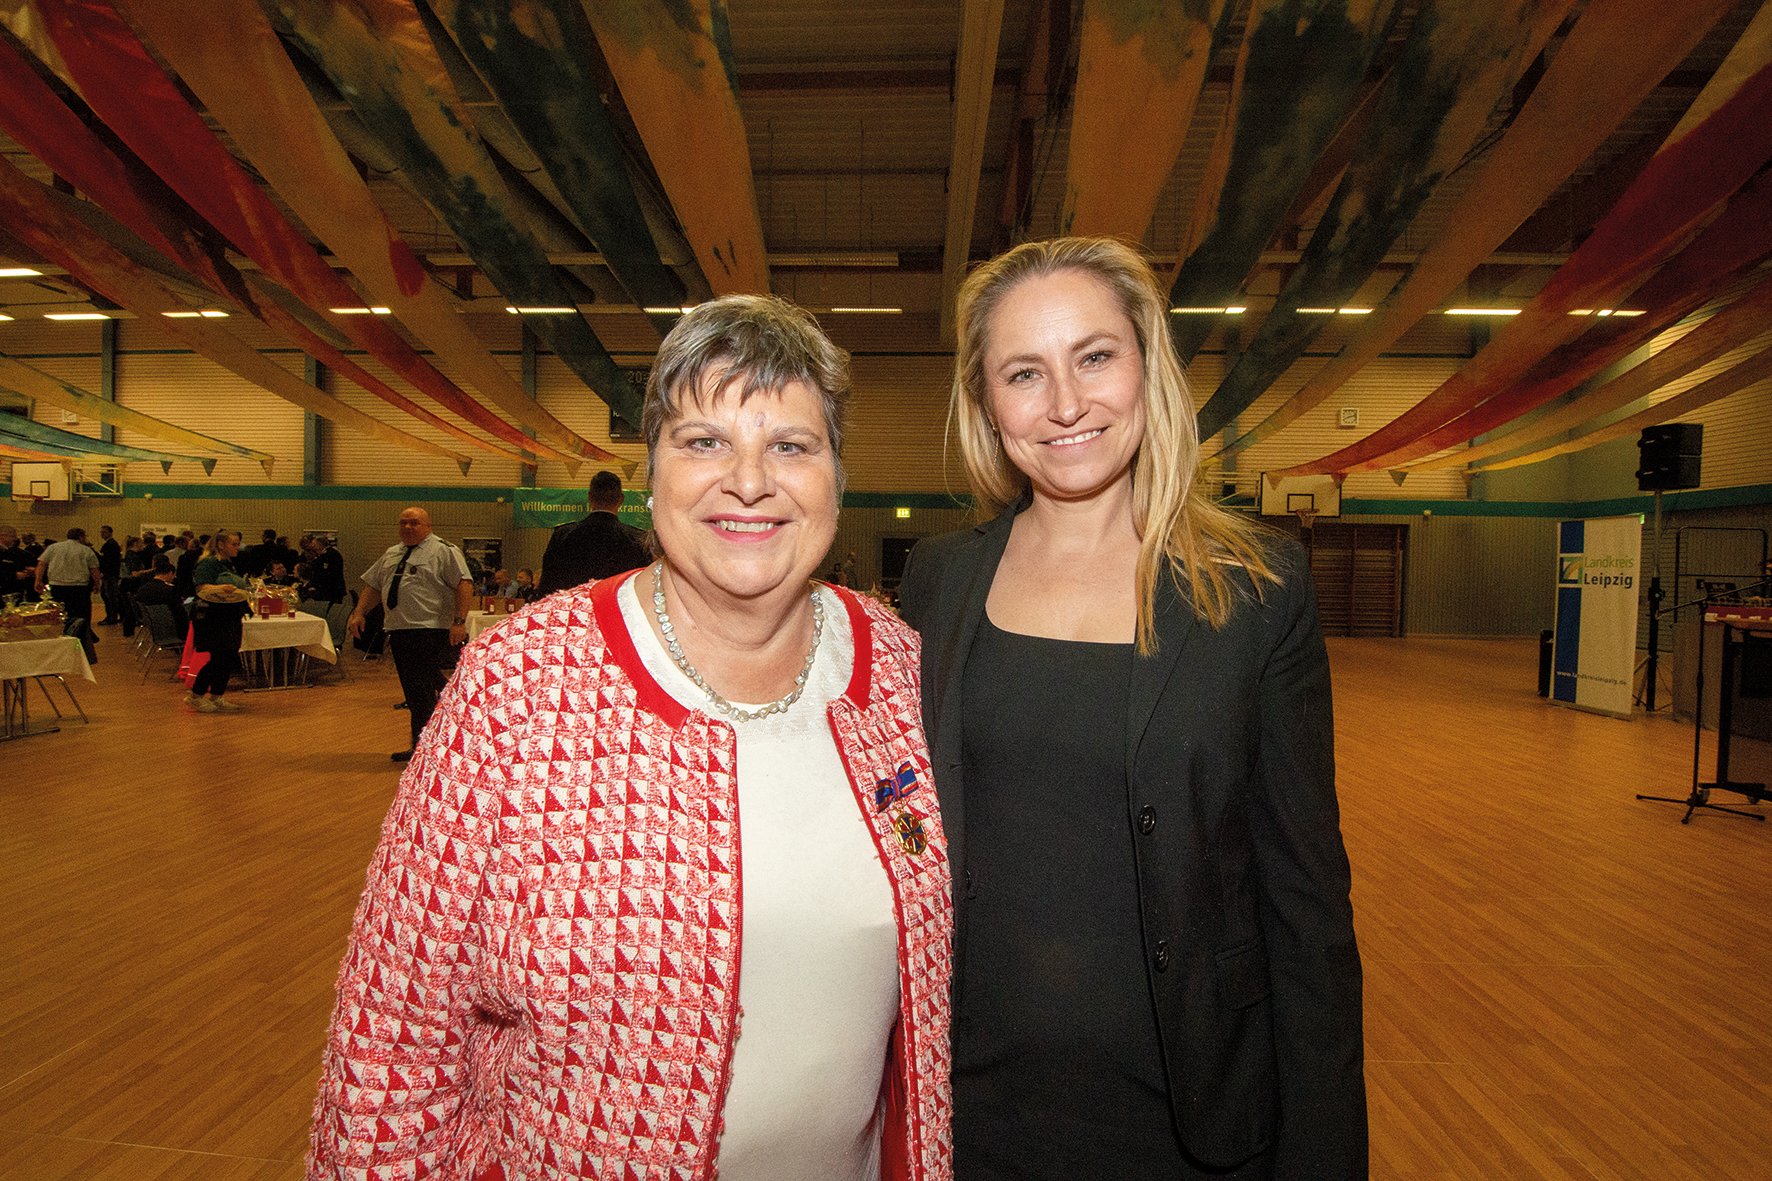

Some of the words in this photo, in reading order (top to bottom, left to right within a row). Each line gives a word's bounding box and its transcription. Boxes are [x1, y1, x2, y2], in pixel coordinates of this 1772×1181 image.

[521, 501, 583, 512] Willkommen
[1584, 555, 1633, 568] Landkreis
[1584, 572, 1633, 589] Leipzig
